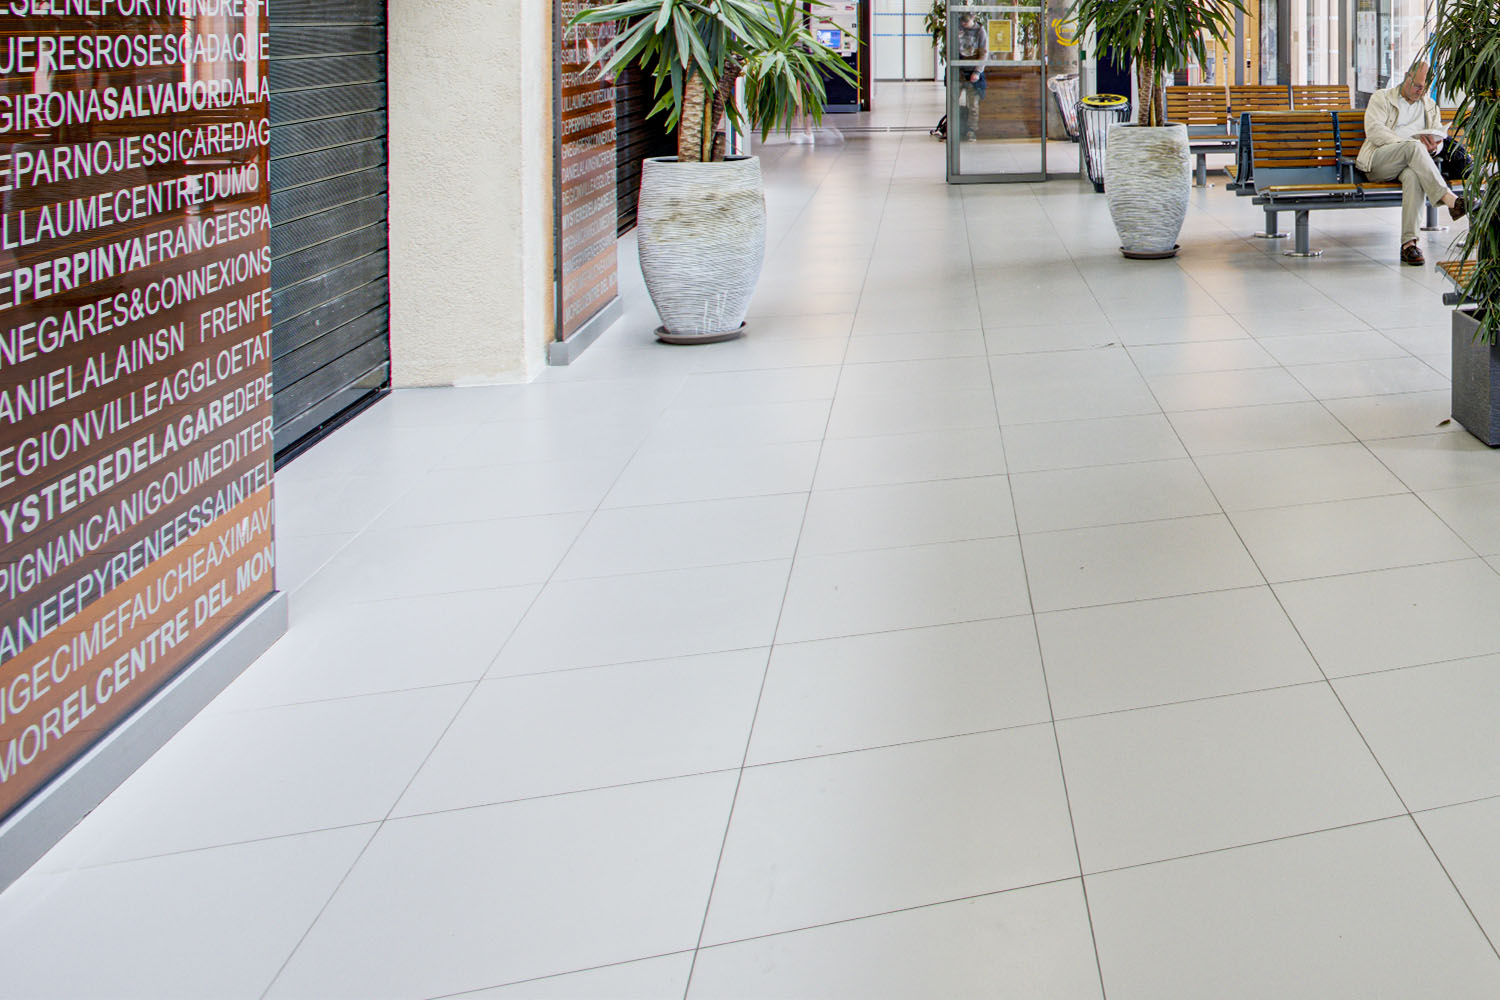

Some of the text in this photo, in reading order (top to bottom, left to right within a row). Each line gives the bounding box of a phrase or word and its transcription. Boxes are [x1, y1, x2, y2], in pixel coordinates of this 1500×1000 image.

[200, 287, 271, 344] FRENFE
[194, 573, 231, 631] DEL
[237, 541, 274, 597] MON
